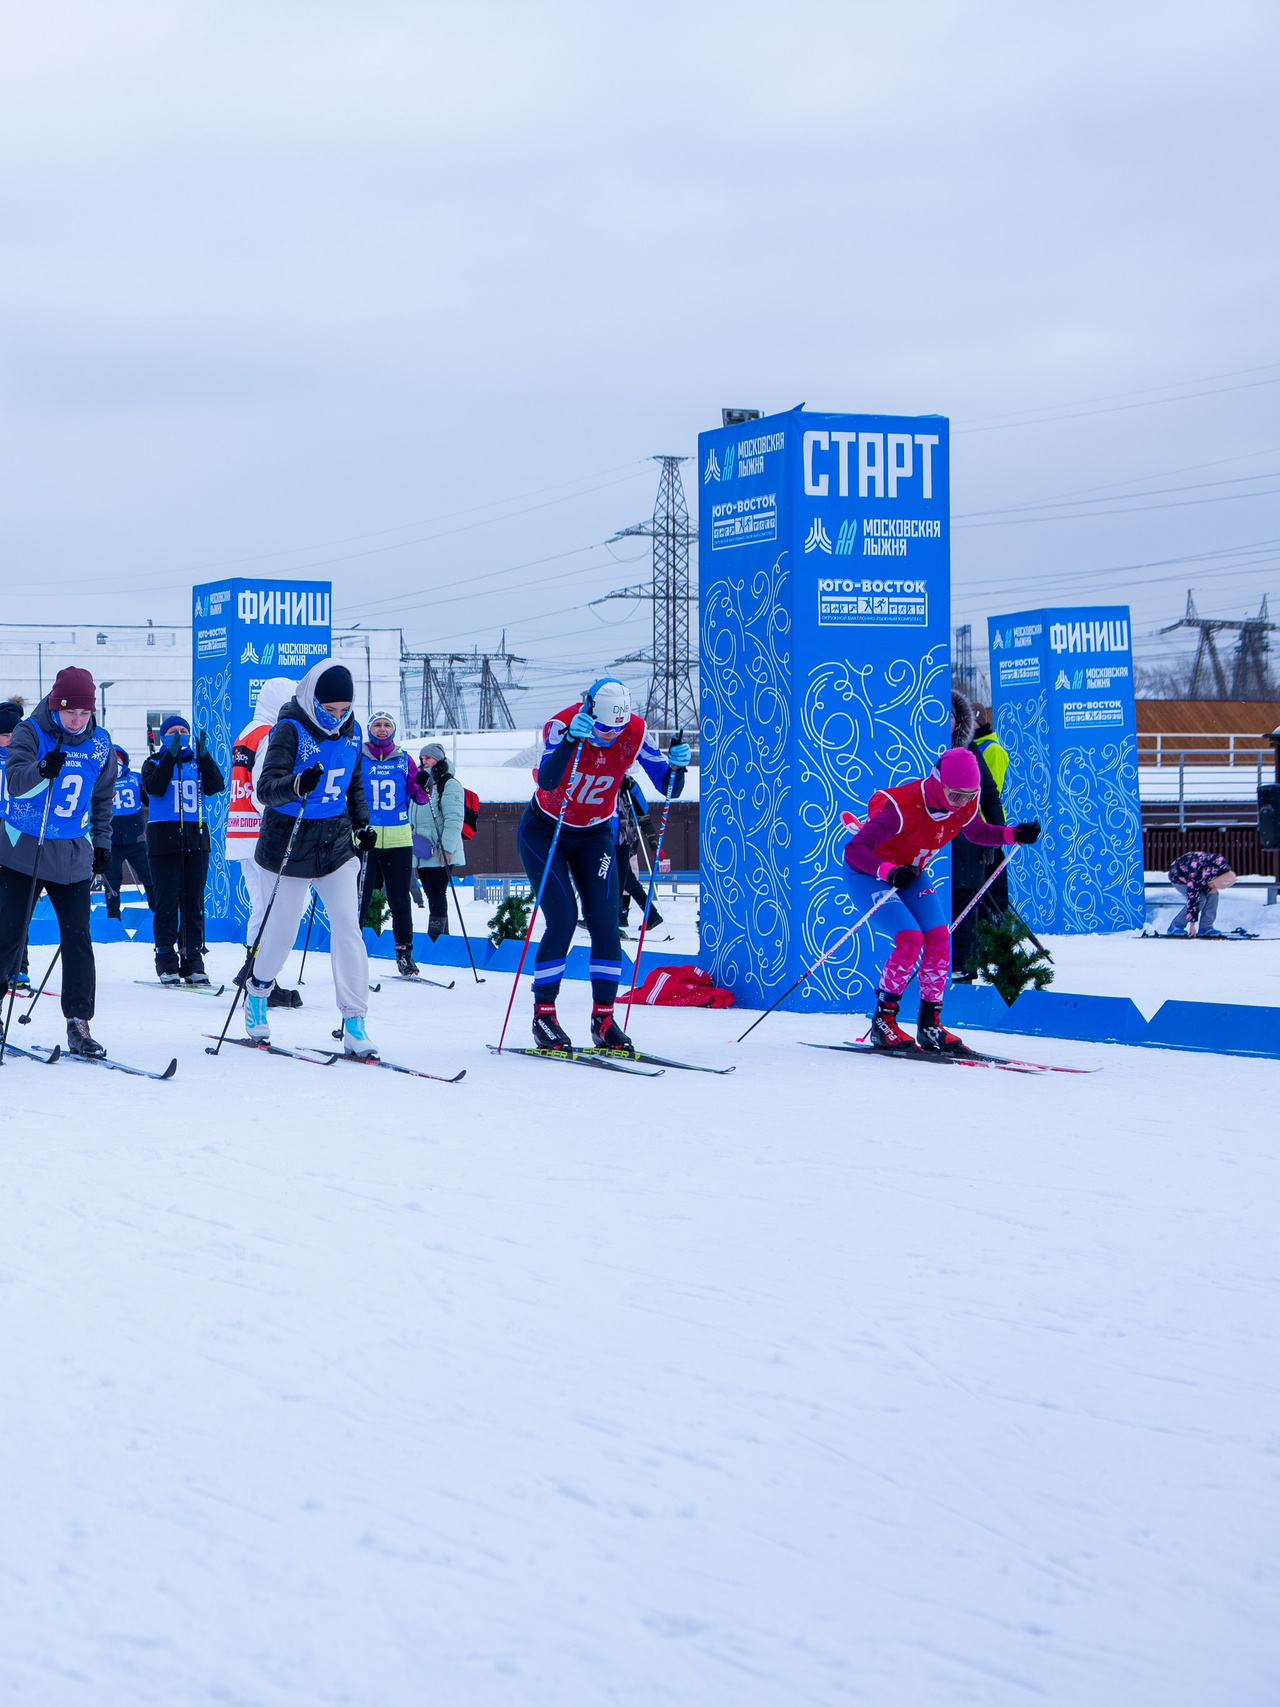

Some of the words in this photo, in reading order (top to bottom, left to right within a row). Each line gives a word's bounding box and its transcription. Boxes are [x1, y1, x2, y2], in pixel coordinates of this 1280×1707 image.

[737, 431, 785, 459] МОСКОВСКАЯ
[737, 455, 765, 478] ЛЫЖНЯ
[802, 430, 939, 499] СТАРТ
[712, 493, 777, 518] ЮГО-ВОСТОК
[862, 518, 941, 538] МОСКОВСКАЯ
[862, 538, 907, 556] ЛЫЖНЯ
[818, 578, 927, 593] ЮГО-ВОСТОК
[237, 589, 330, 626] ФИНИШ
[198, 627, 227, 639] ЮГО-ВОСТОК
[1049, 620, 1129, 654] ФИНИШ
[278, 643, 328, 655] МОСКОВСКАЯ
[278, 655, 306, 666] ЛЫЖНЯ
[1000, 657, 1039, 668] ЮГО-ВОСТОК
[1086, 667, 1128, 678] МОСКОВСКАЯ
[1086, 678, 1111, 690] ЛЫЖНЯ
[1063, 700, 1122, 711] ЮГО-ВОСТОК
[54, 774, 83, 818] 3
[322, 768, 345, 804] 5
[371, 779, 396, 811] 13
[568, 771, 614, 804] 112
[172, 780, 197, 813] 19
[240, 817, 261, 827] СПОРТ
[876, 1017, 898, 1042] alpina
[525, 1048, 568, 1059] FISCHER
[582, 1047, 630, 1058] FISCHER
